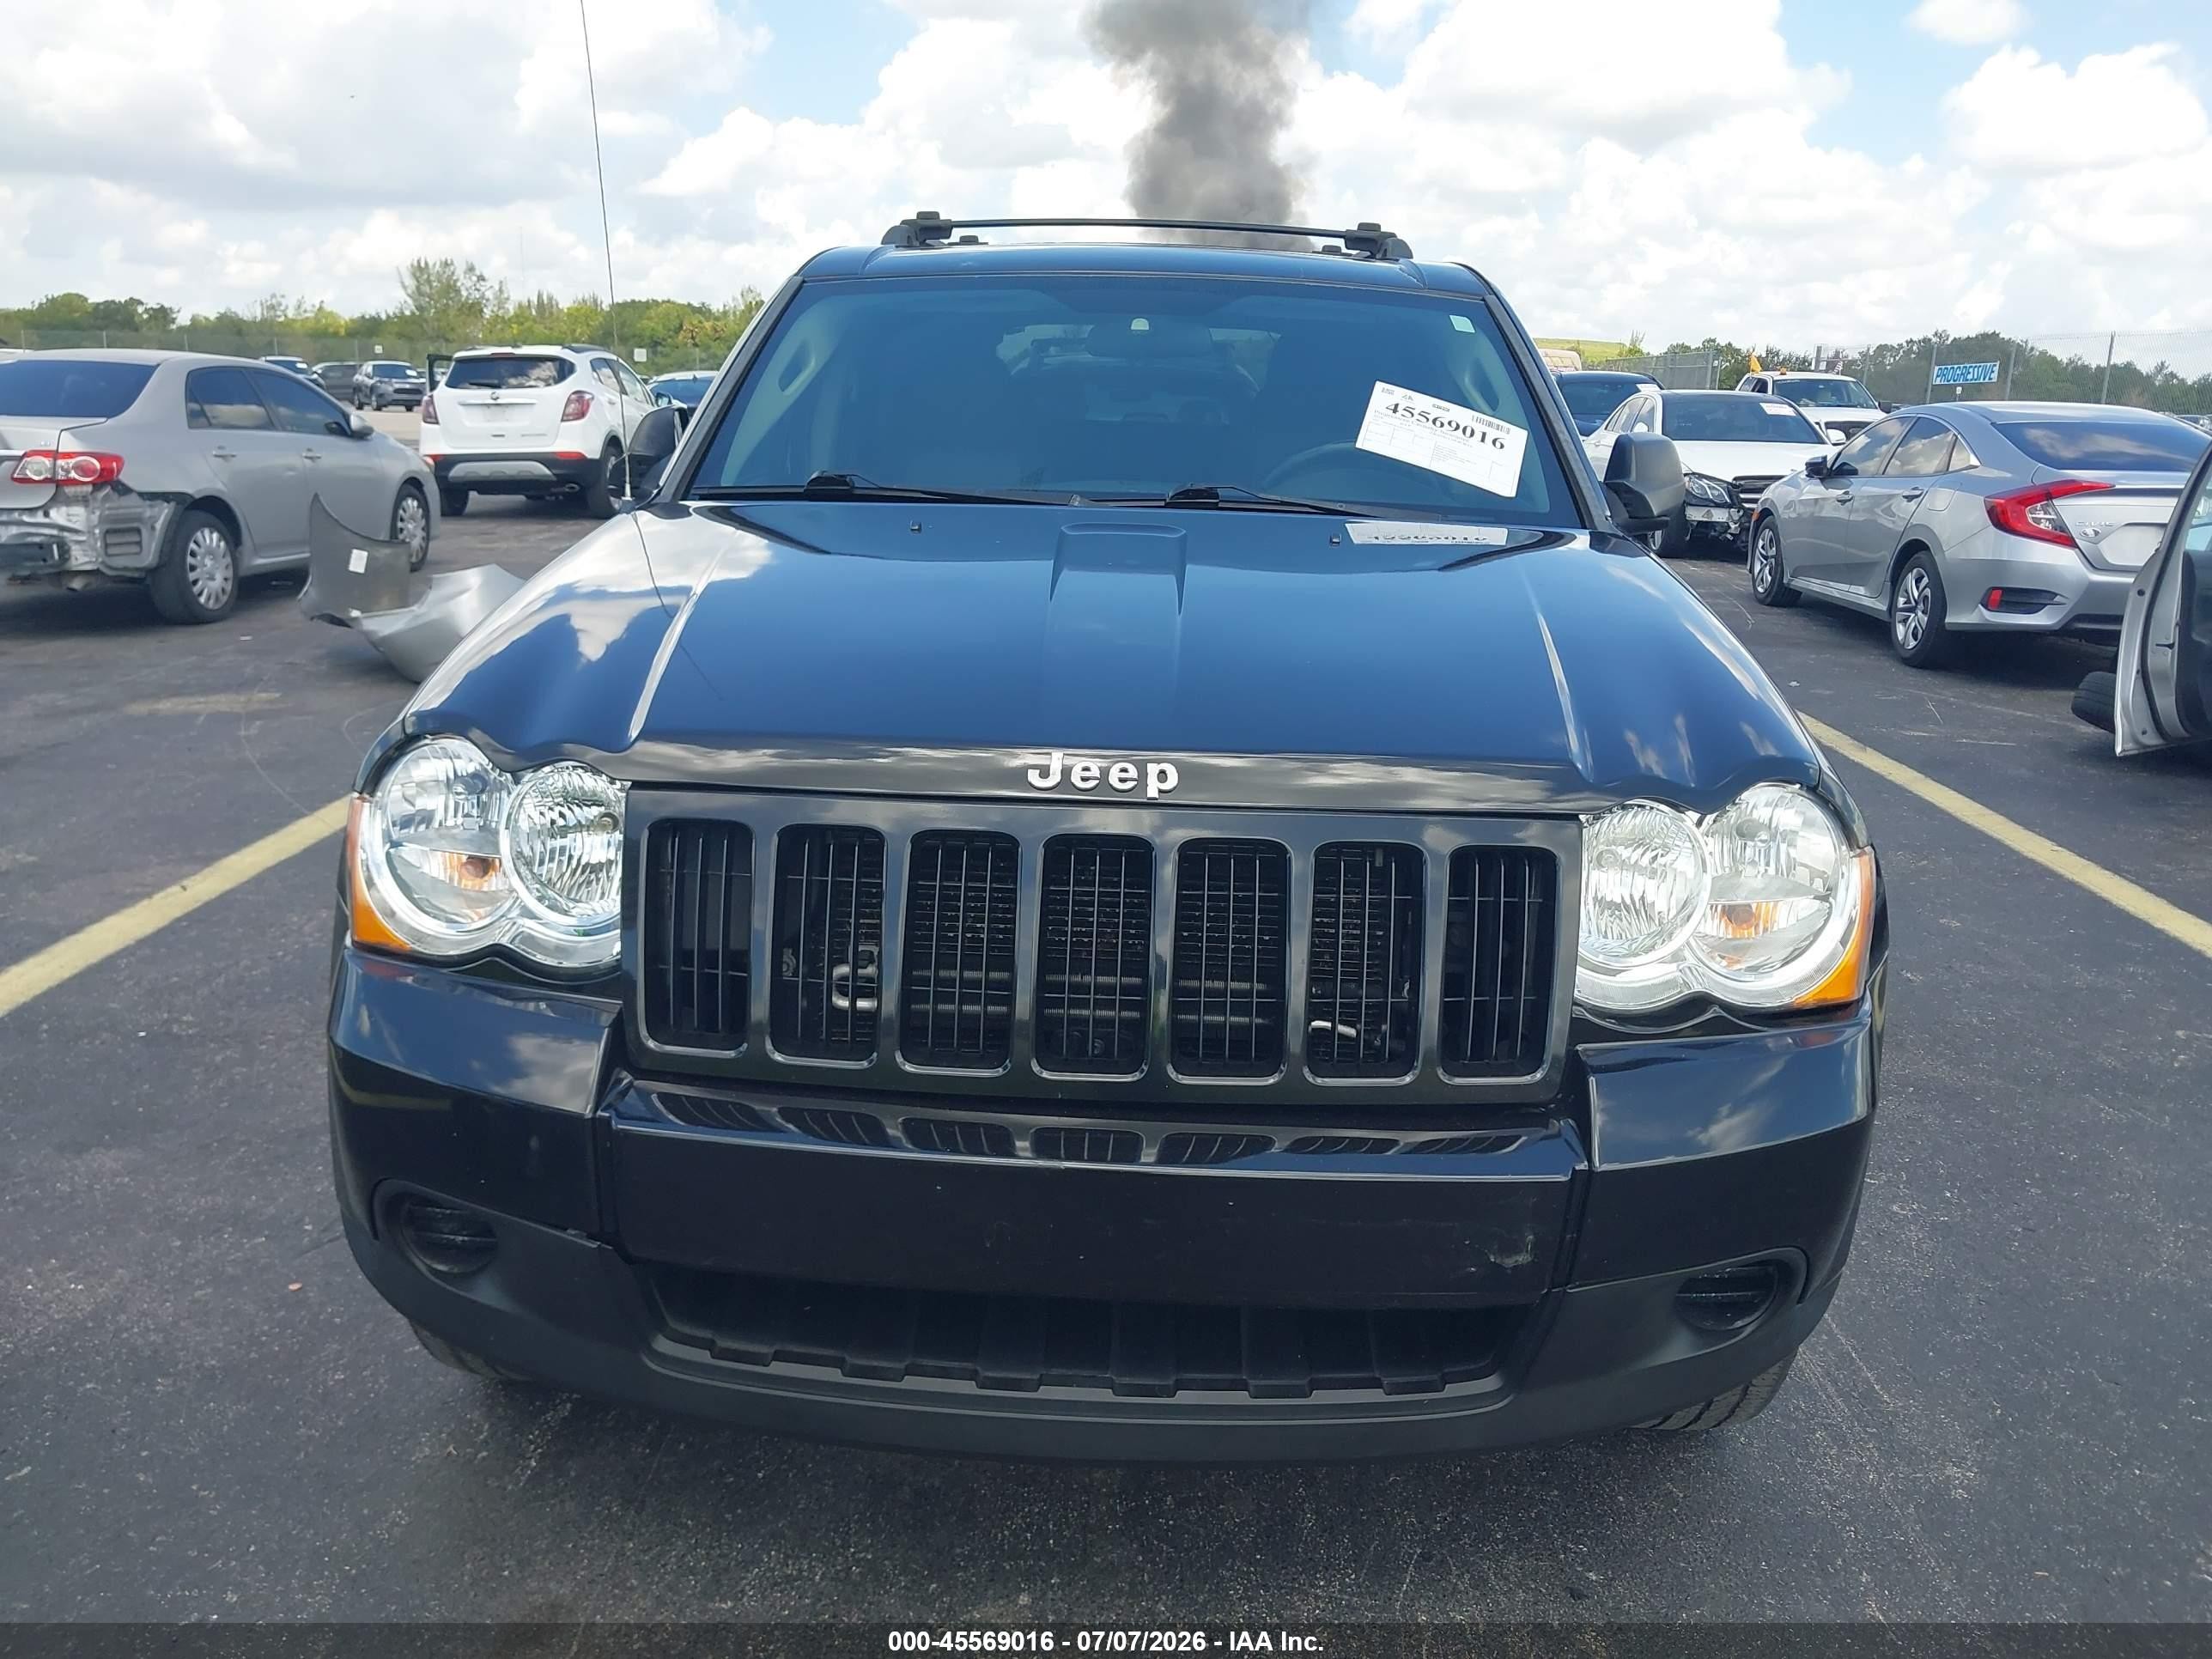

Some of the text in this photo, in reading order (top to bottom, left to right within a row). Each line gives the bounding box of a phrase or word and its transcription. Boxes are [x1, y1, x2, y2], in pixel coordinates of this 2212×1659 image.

[1935, 363, 1998, 383] PROGRESSIVE
[1385, 403, 1506, 450] 45569016
[1027, 751, 1179, 800] Jeep
